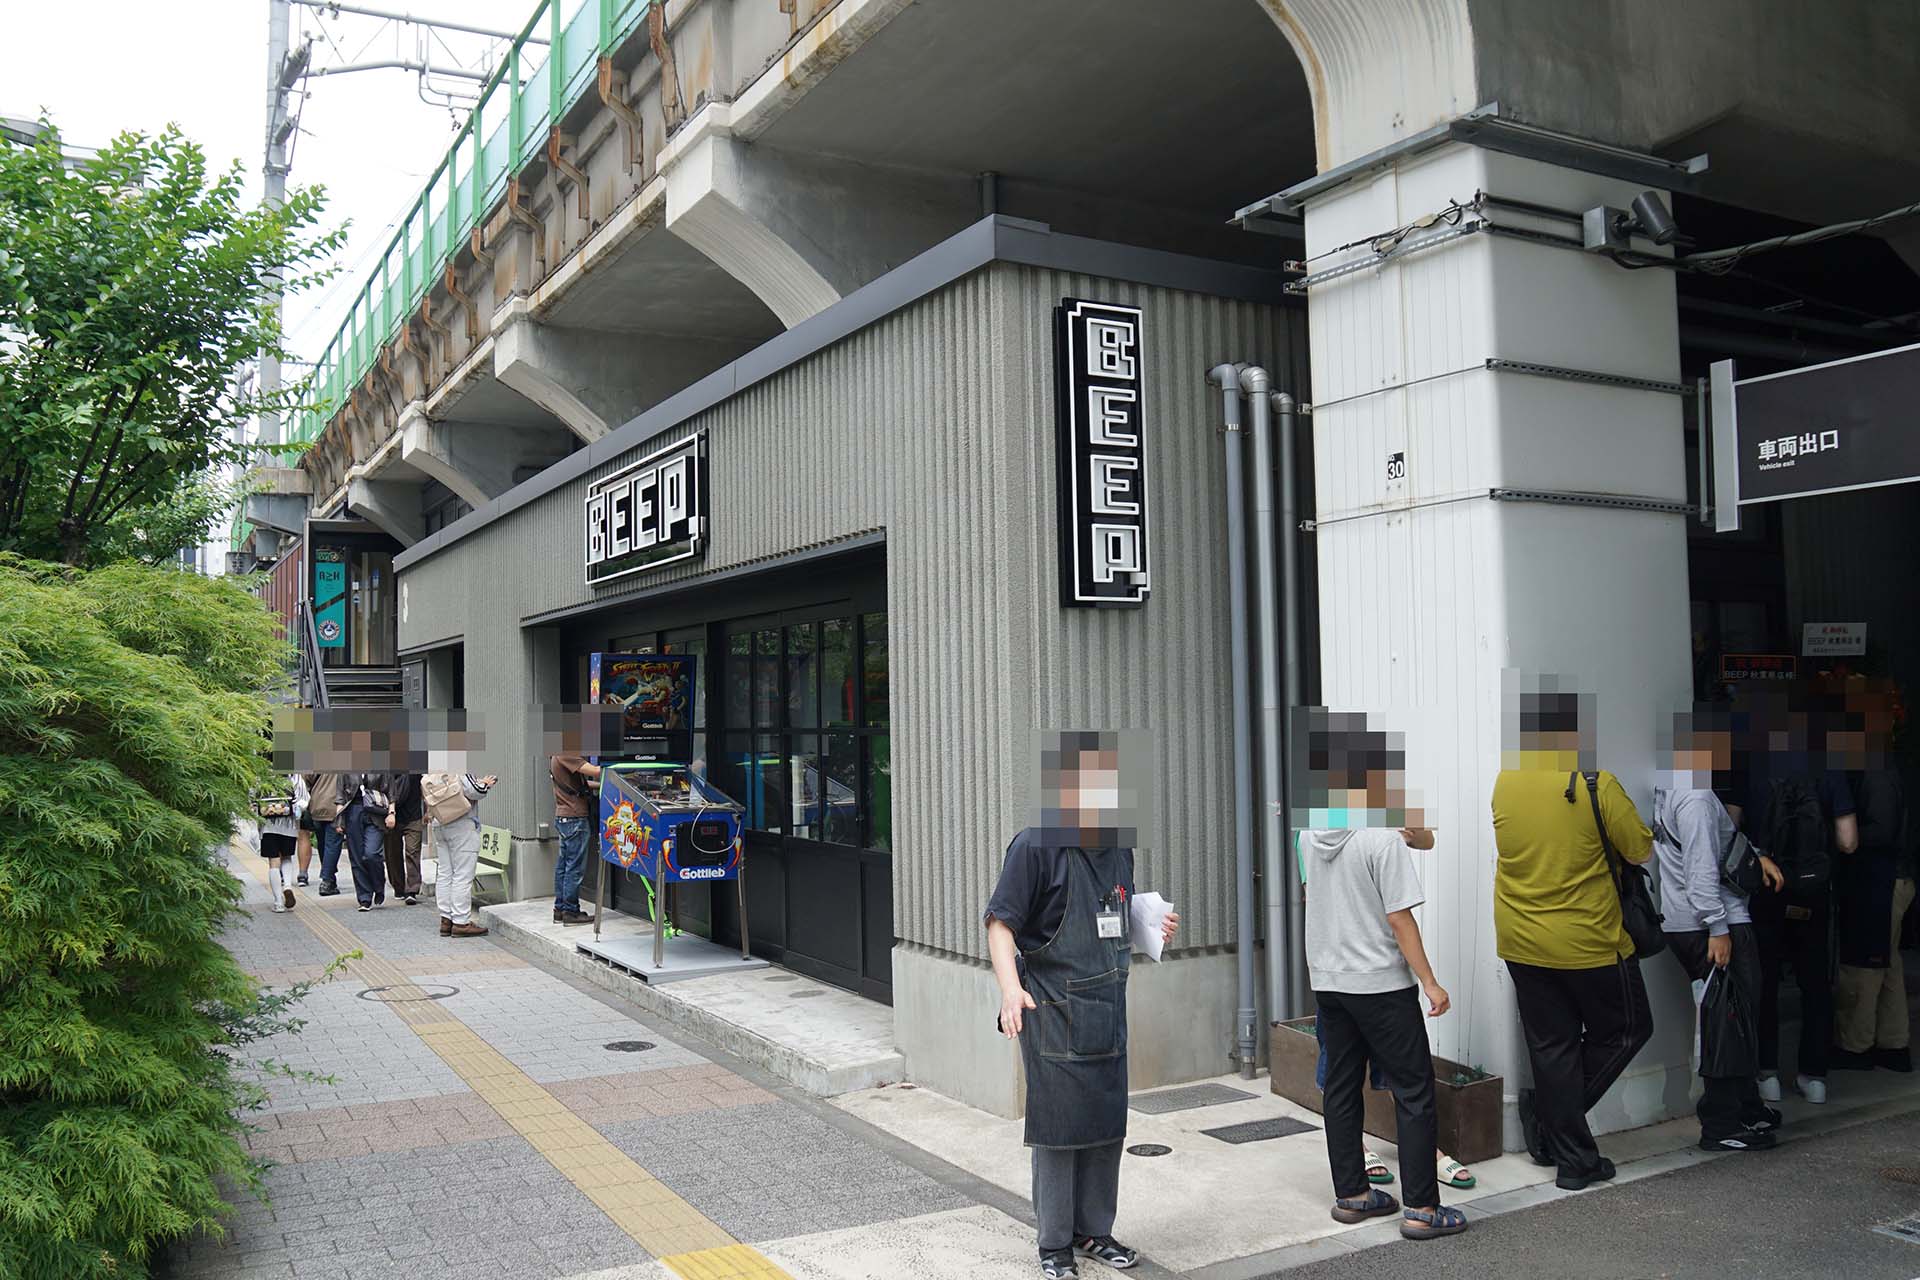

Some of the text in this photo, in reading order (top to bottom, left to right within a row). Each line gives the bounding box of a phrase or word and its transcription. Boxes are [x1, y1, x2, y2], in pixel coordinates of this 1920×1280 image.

[1086, 317, 1140, 583] BEEP
[1757, 429, 1840, 461] 車両出口
[1388, 460, 1404, 479] 30
[1758, 459, 1795, 471] Vehicle exit
[585, 455, 687, 564] BEEP
[679, 867, 726, 880] Gottlieb
